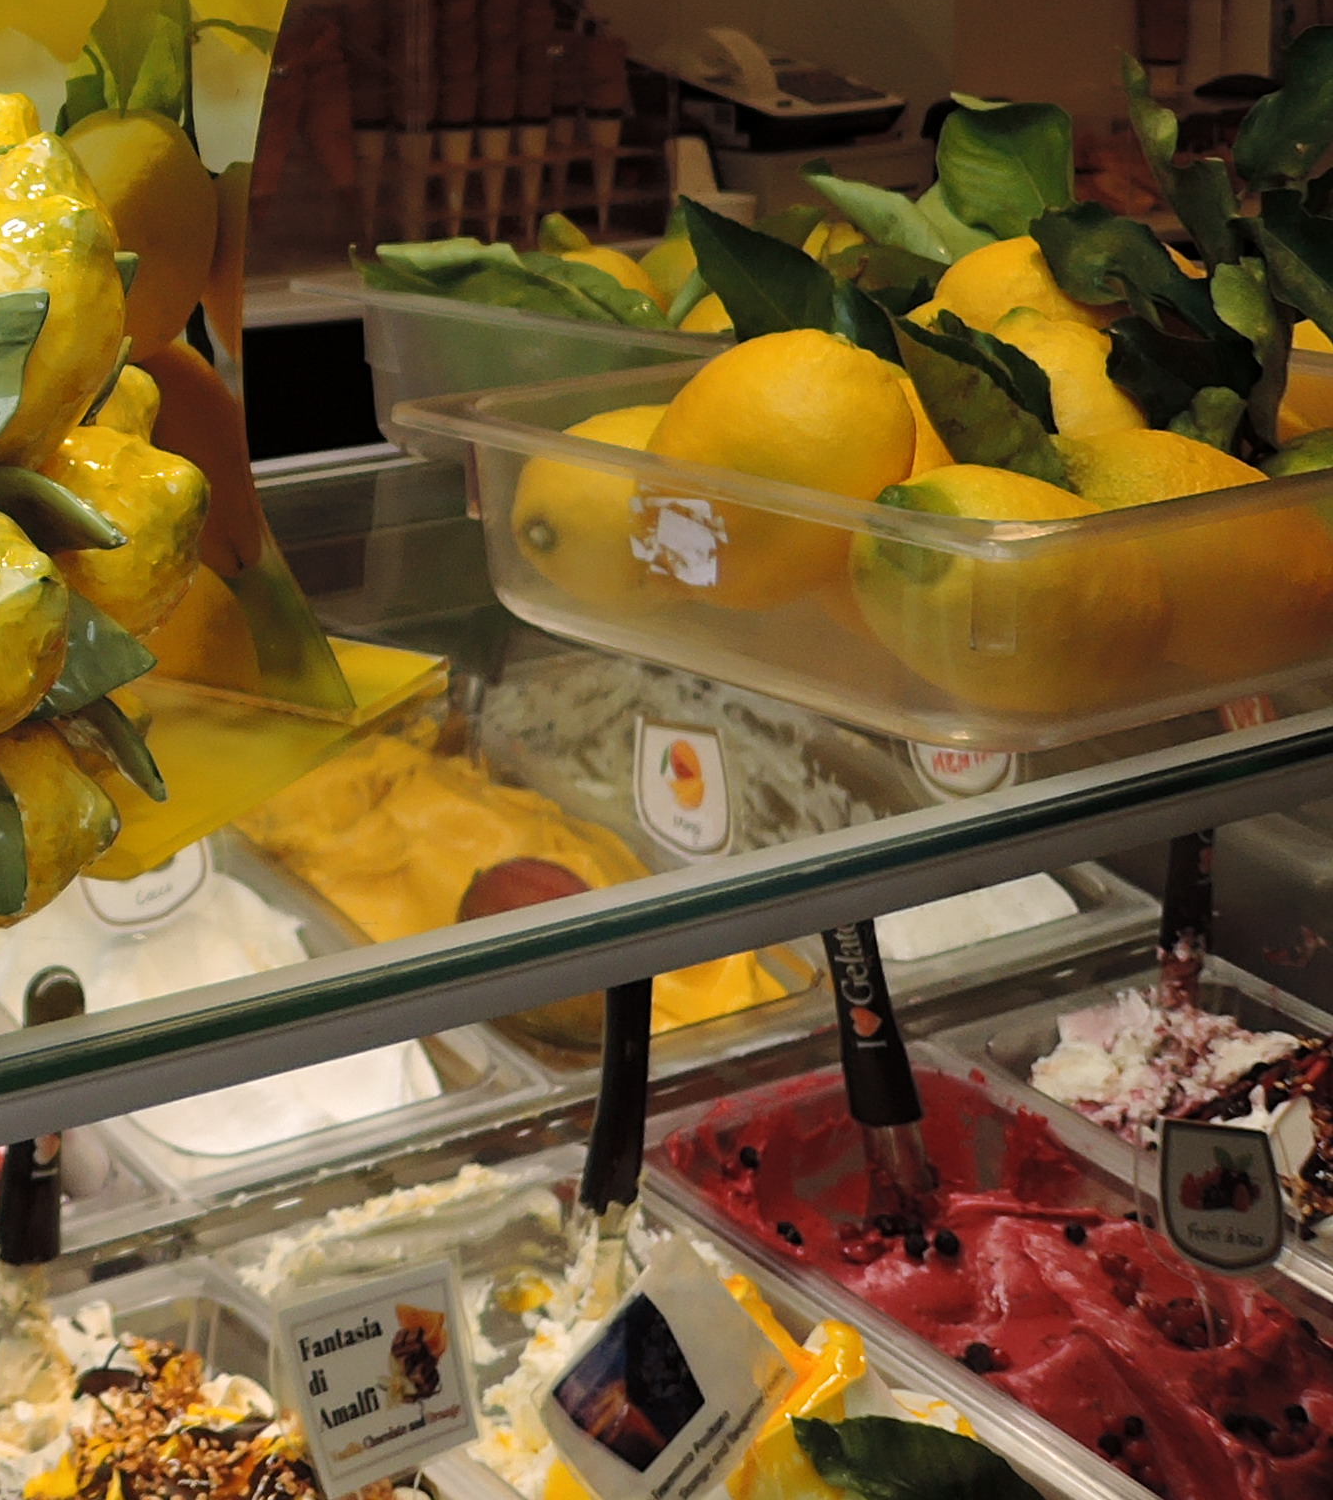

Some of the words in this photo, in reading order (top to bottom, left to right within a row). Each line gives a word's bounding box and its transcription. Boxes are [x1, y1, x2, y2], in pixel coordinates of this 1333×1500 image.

[297, 1316, 382, 1362] Fantasia
[308, 1369, 329, 1397] di
[319, 1386, 380, 1433] Amalfi
